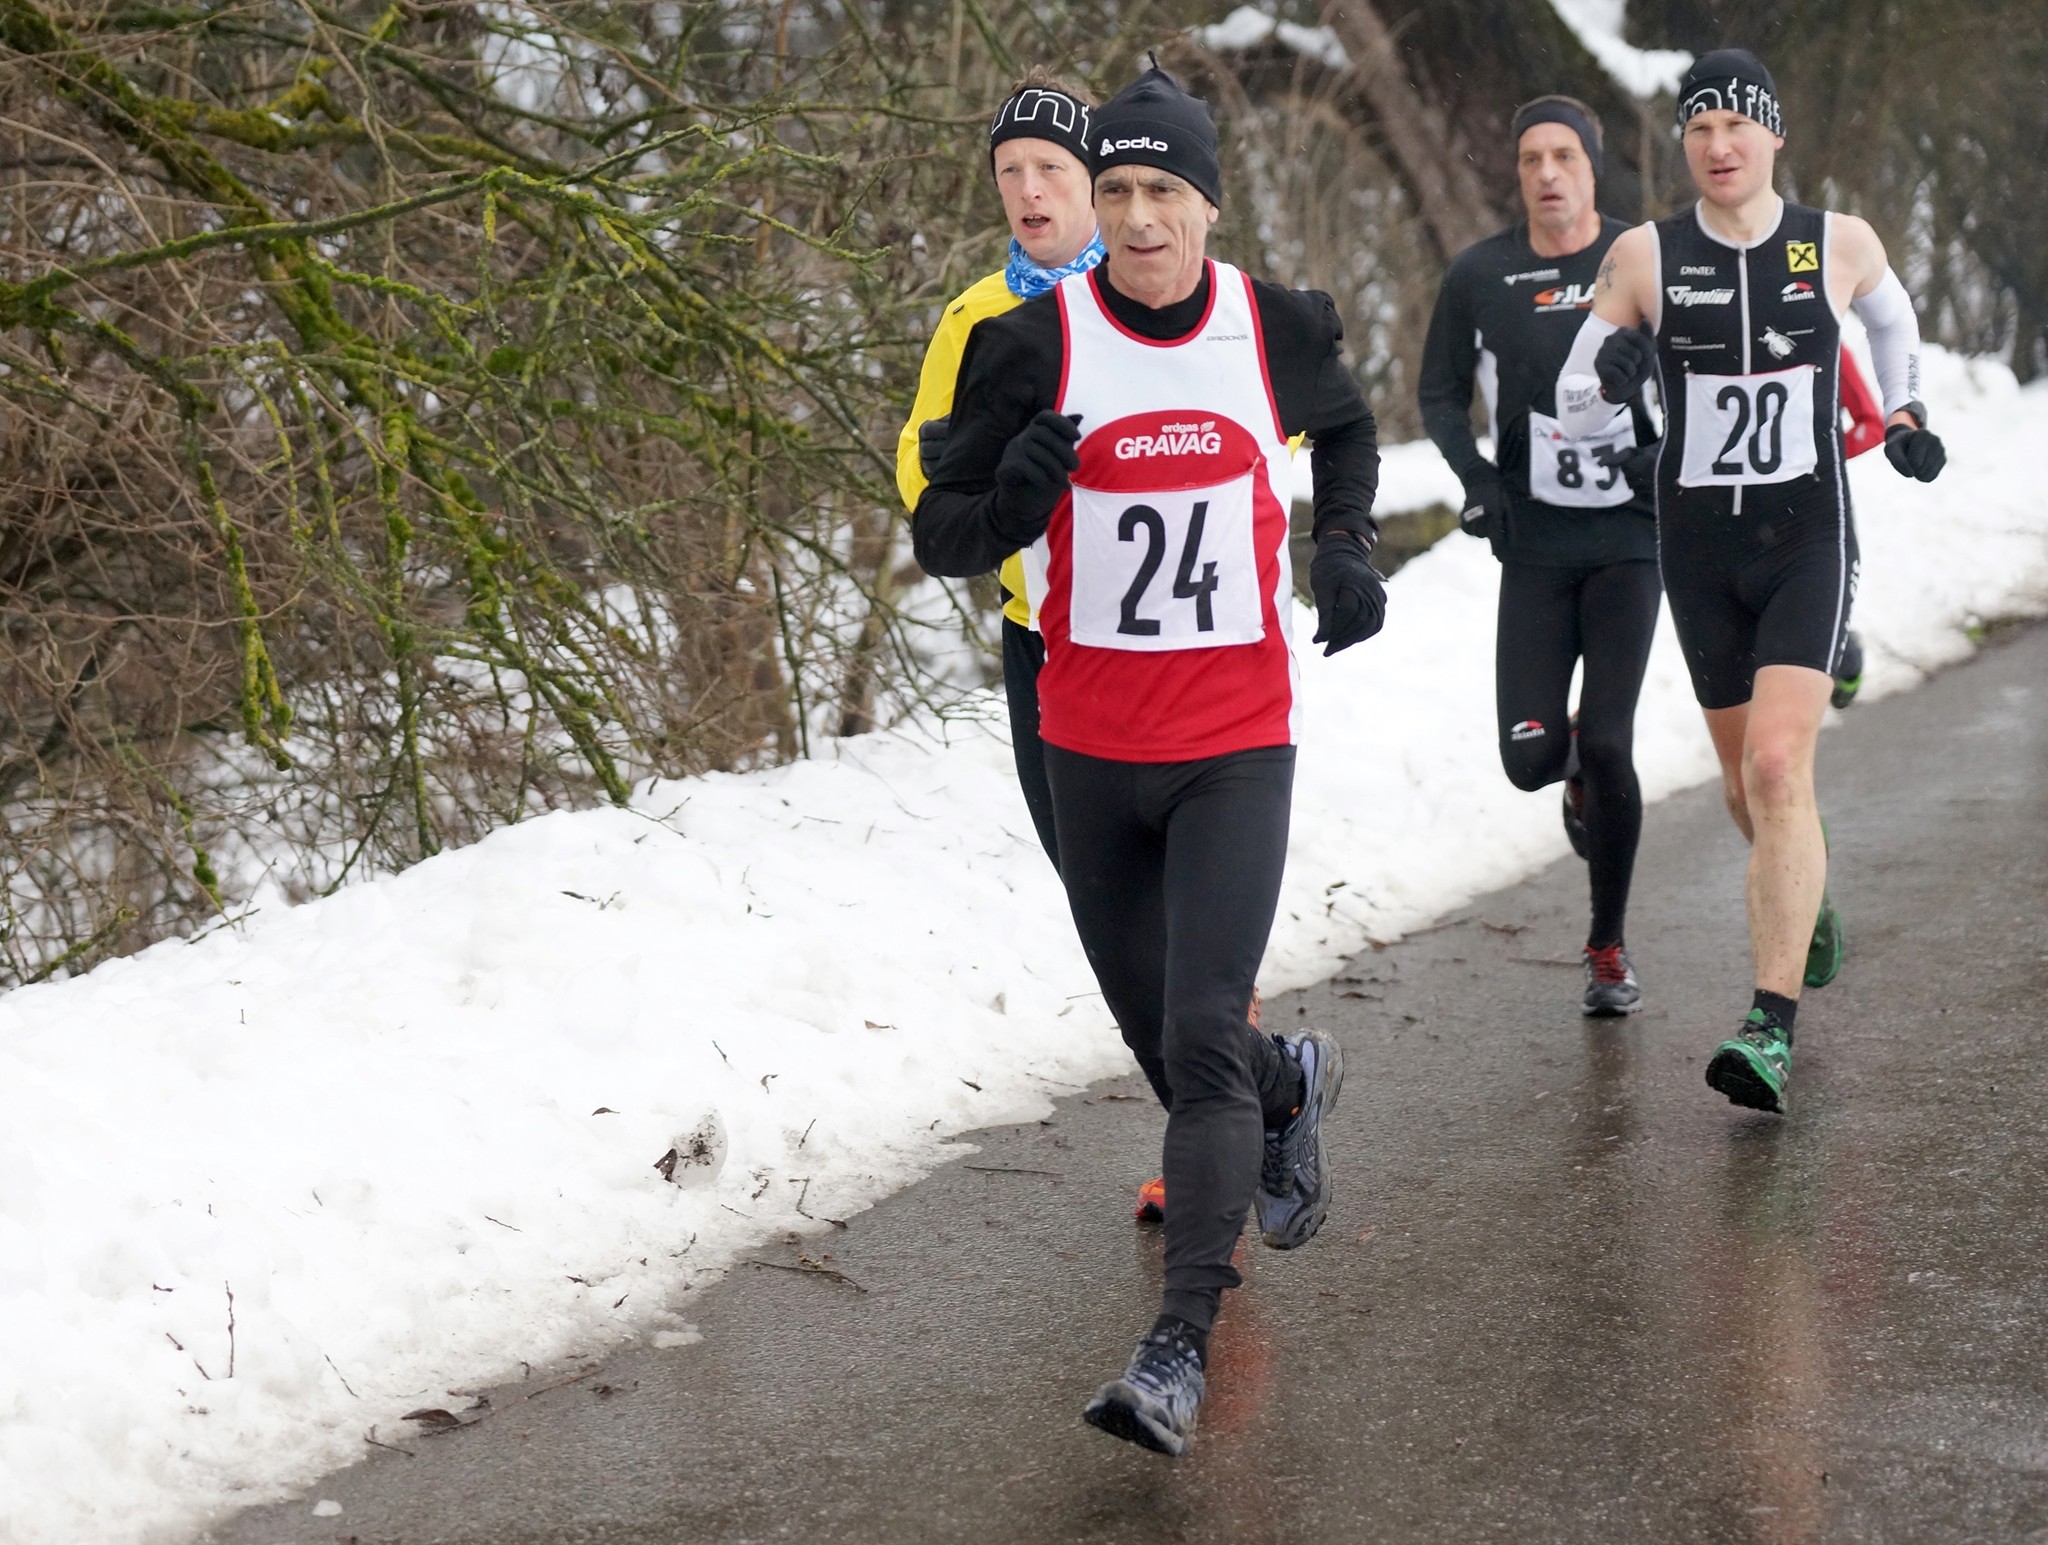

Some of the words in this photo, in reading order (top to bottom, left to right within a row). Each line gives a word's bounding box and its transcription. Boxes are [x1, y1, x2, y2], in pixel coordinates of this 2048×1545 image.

[1115, 137, 1168, 152] odlo
[1781, 291, 1816, 302] skinfit
[1161, 422, 1199, 433] erdgas
[1712, 381, 1788, 475] 20
[1115, 432, 1221, 459] GRAVAG
[1557, 444, 1620, 491] 83
[1117, 501, 1219, 636] 24
